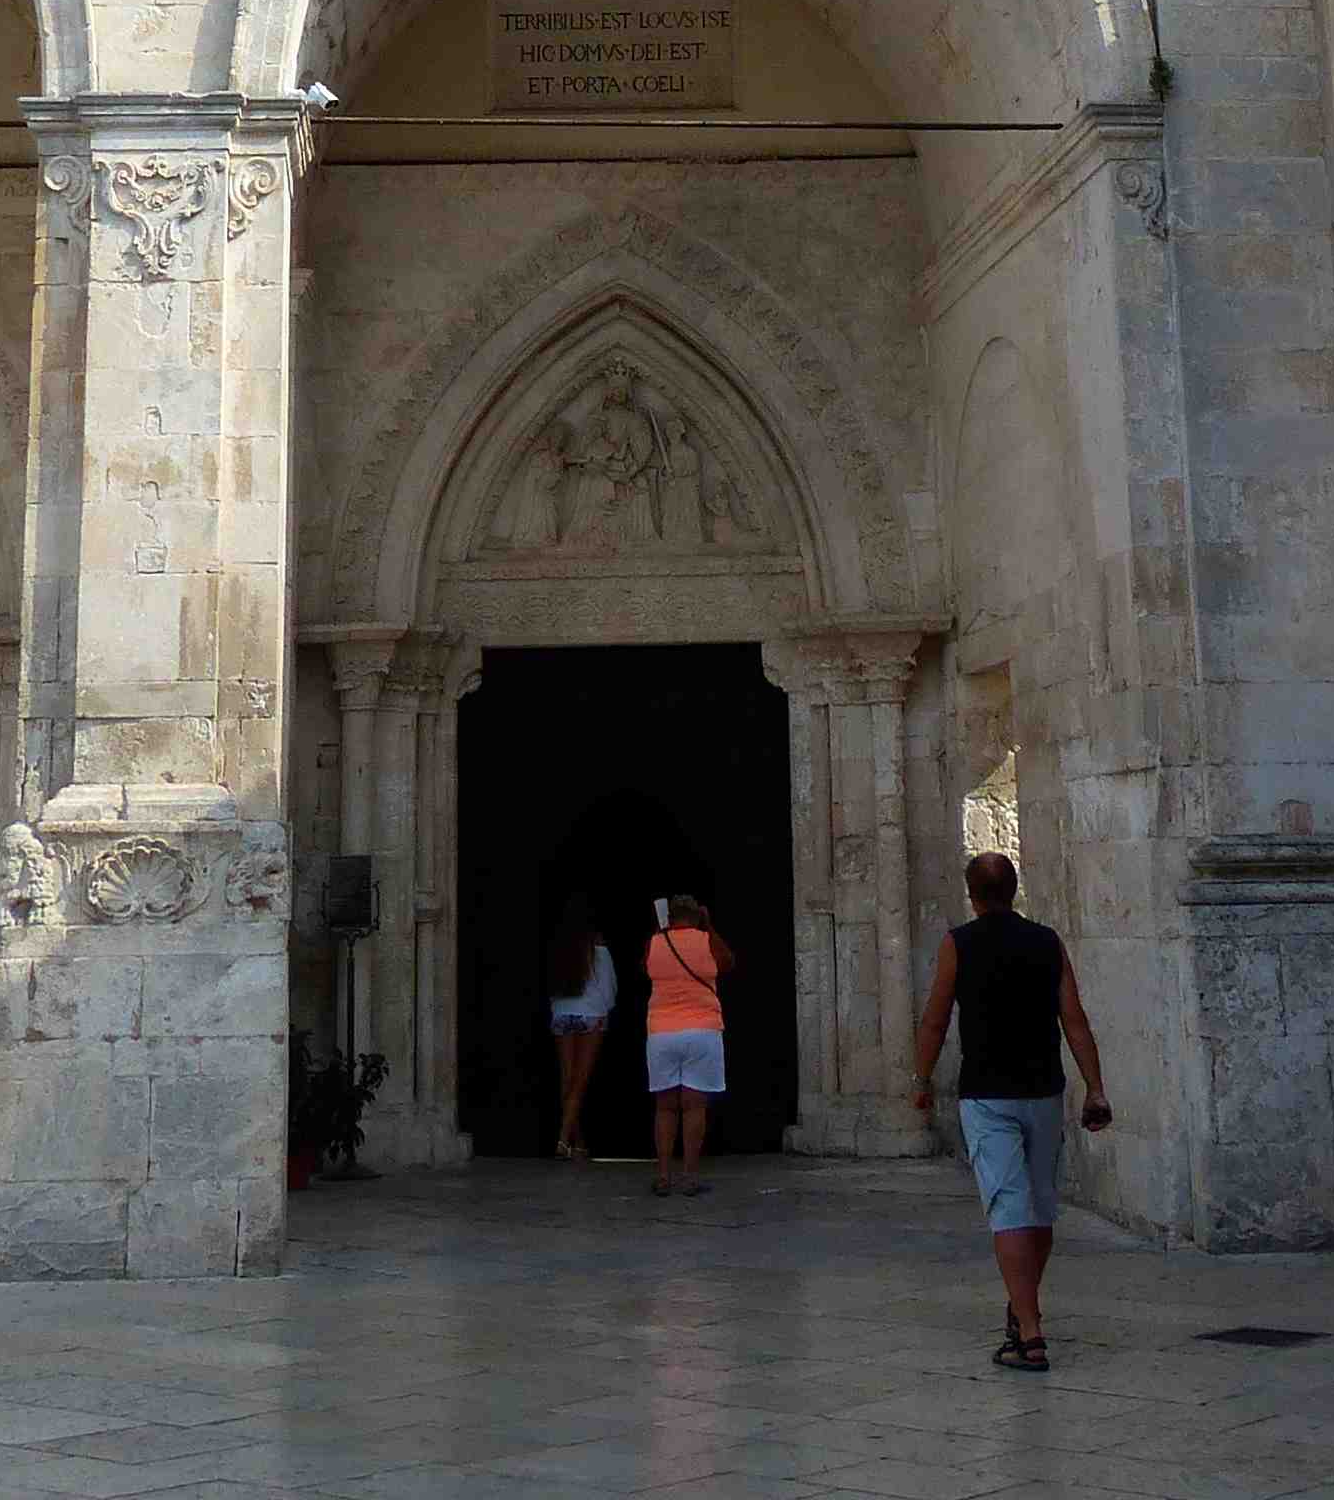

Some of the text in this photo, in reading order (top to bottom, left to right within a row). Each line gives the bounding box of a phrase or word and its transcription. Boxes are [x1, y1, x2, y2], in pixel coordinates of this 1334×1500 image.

[499, 11, 595, 31] TERRIBILIS
[601, 11, 632, 30] EST
[639, 10, 694, 29] LOCVS
[520, 41, 704, 62] HIC DOMVS DEI EST
[528, 75, 685, 95] ET PORTA COELI
